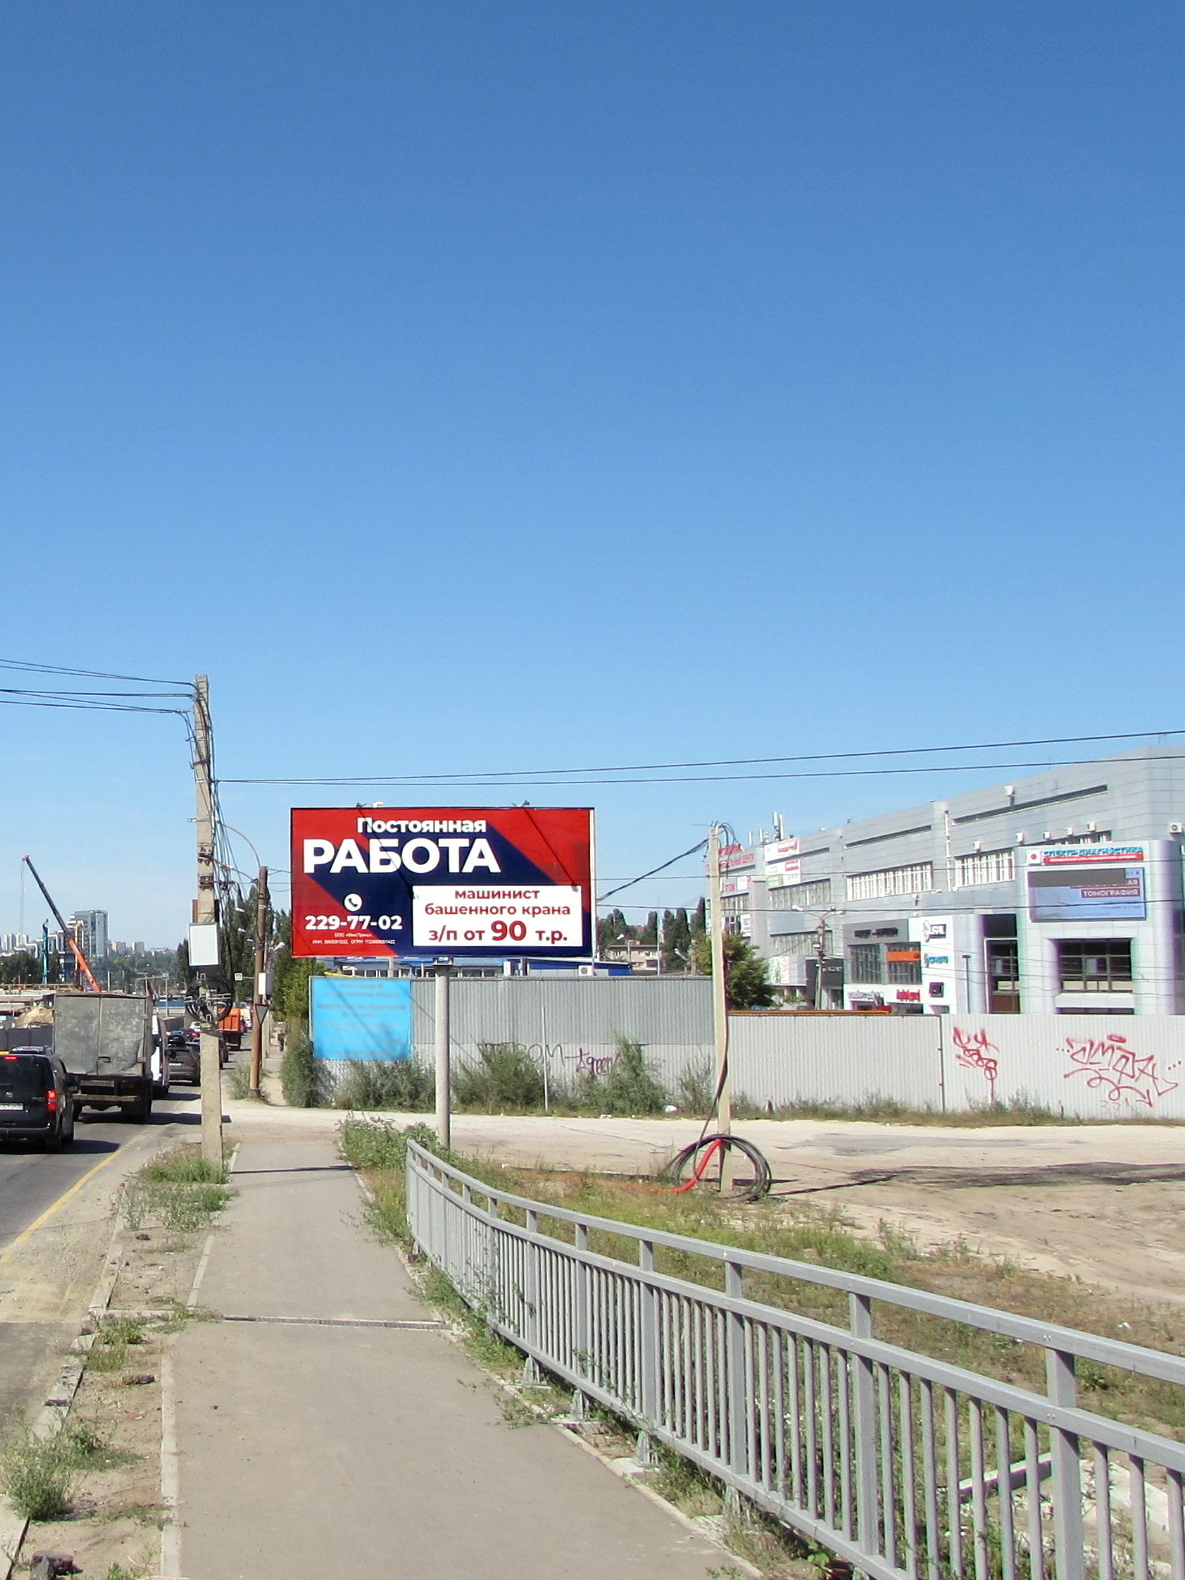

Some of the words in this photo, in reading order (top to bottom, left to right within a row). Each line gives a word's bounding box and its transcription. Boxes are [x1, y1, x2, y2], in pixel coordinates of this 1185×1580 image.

[357, 817, 486, 833] Постоянная
[303, 837, 502, 874] РАБОТА
[454, 890, 540, 899] машинист
[1083, 888, 1138, 898] ТОМОГРАФИЯ
[424, 903, 517, 915] башенного
[522, 905, 571, 918] крана
[304, 915, 403, 930] 229-77-02
[428, 925, 458, 942] з/п
[463, 930, 485, 941] от
[490, 920, 527, 942] 90
[535, 930, 568, 945] т.р.
